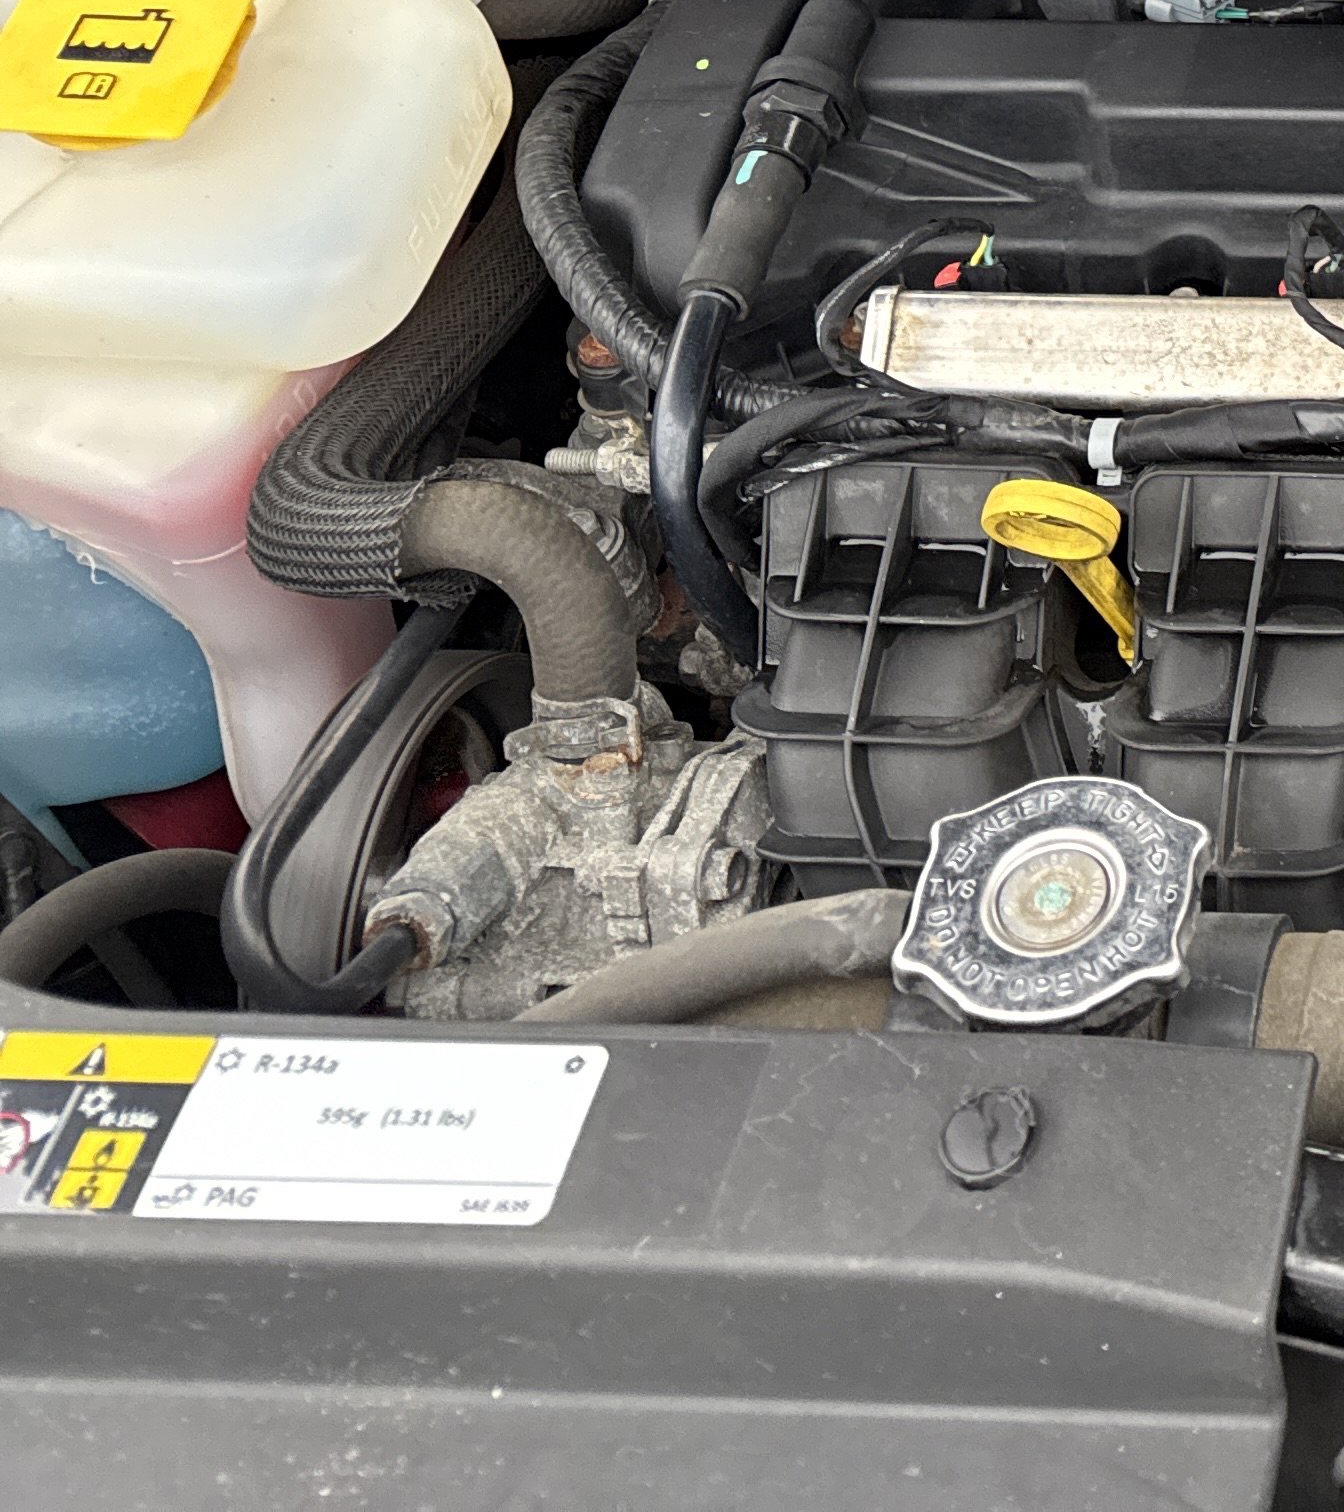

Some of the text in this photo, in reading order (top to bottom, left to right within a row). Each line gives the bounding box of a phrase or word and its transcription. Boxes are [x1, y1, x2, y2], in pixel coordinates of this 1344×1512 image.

[972, 788, 1166, 845] KEEP TIGHT
[928, 877, 977, 900] TVS
[925, 904, 1158, 1002] DO NOT OPEN HOT
[253, 1054, 339, 1076] R-134a
[316, 1106, 477, 1131] 595g (1.31 lbs)
[203, 1186, 258, 1208] PAG
